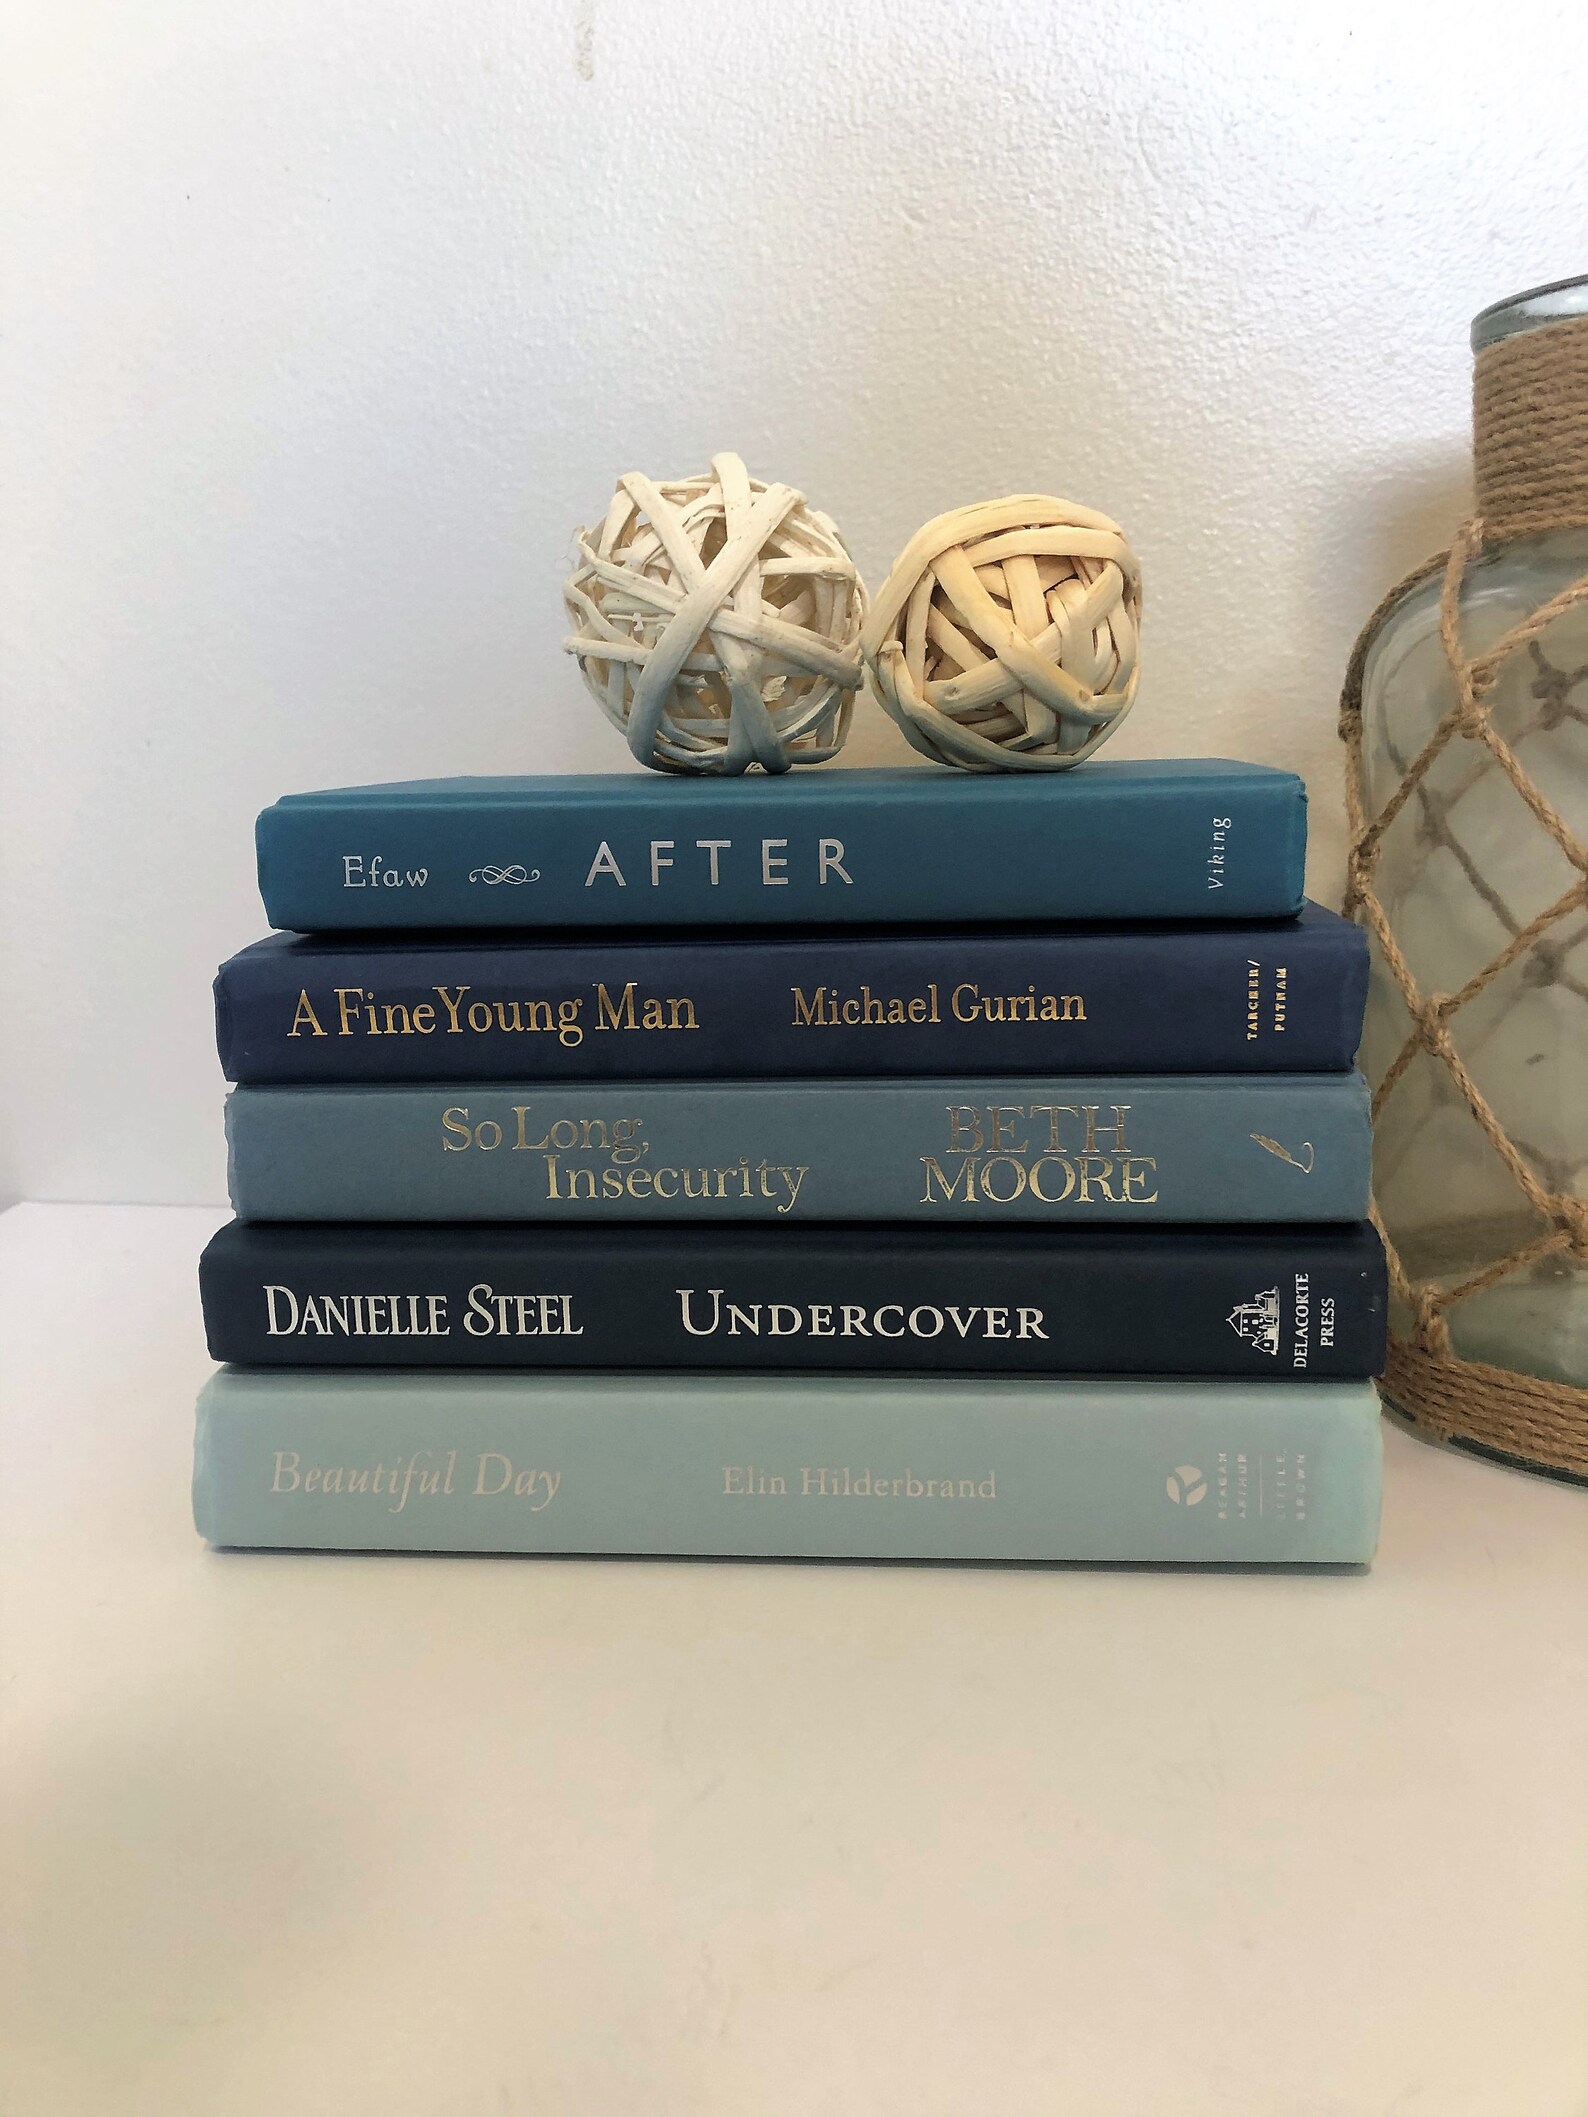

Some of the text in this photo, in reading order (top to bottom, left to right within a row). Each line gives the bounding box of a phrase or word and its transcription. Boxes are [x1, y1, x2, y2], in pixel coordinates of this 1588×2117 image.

[342, 855, 429, 887] Efaw
[584, 838, 854, 887] AFTER
[1207, 817, 1232, 889] Viking
[286, 982, 700, 1047] A Fine Young Man
[790, 982, 1088, 1026] Michael Gurian
[1273, 967, 1288, 1032] PUTNAM
[441, 1105, 650, 1164] So Long,
[945, 1104, 1133, 1153] BETH
[543, 1153, 810, 1213] Insecurity
[919, 1155, 1159, 1204] MOORE
[262, 1283, 584, 1337] DANIELLE STEEL
[675, 1288, 1050, 1340] UNDERCOVER
[1293, 1273, 1310, 1368] DELACORTE
[1320, 1297, 1335, 1347] PRESS
[271, 1450, 562, 1513] Beautiful Day
[721, 1465, 997, 1500] Elin Hilderbrand
